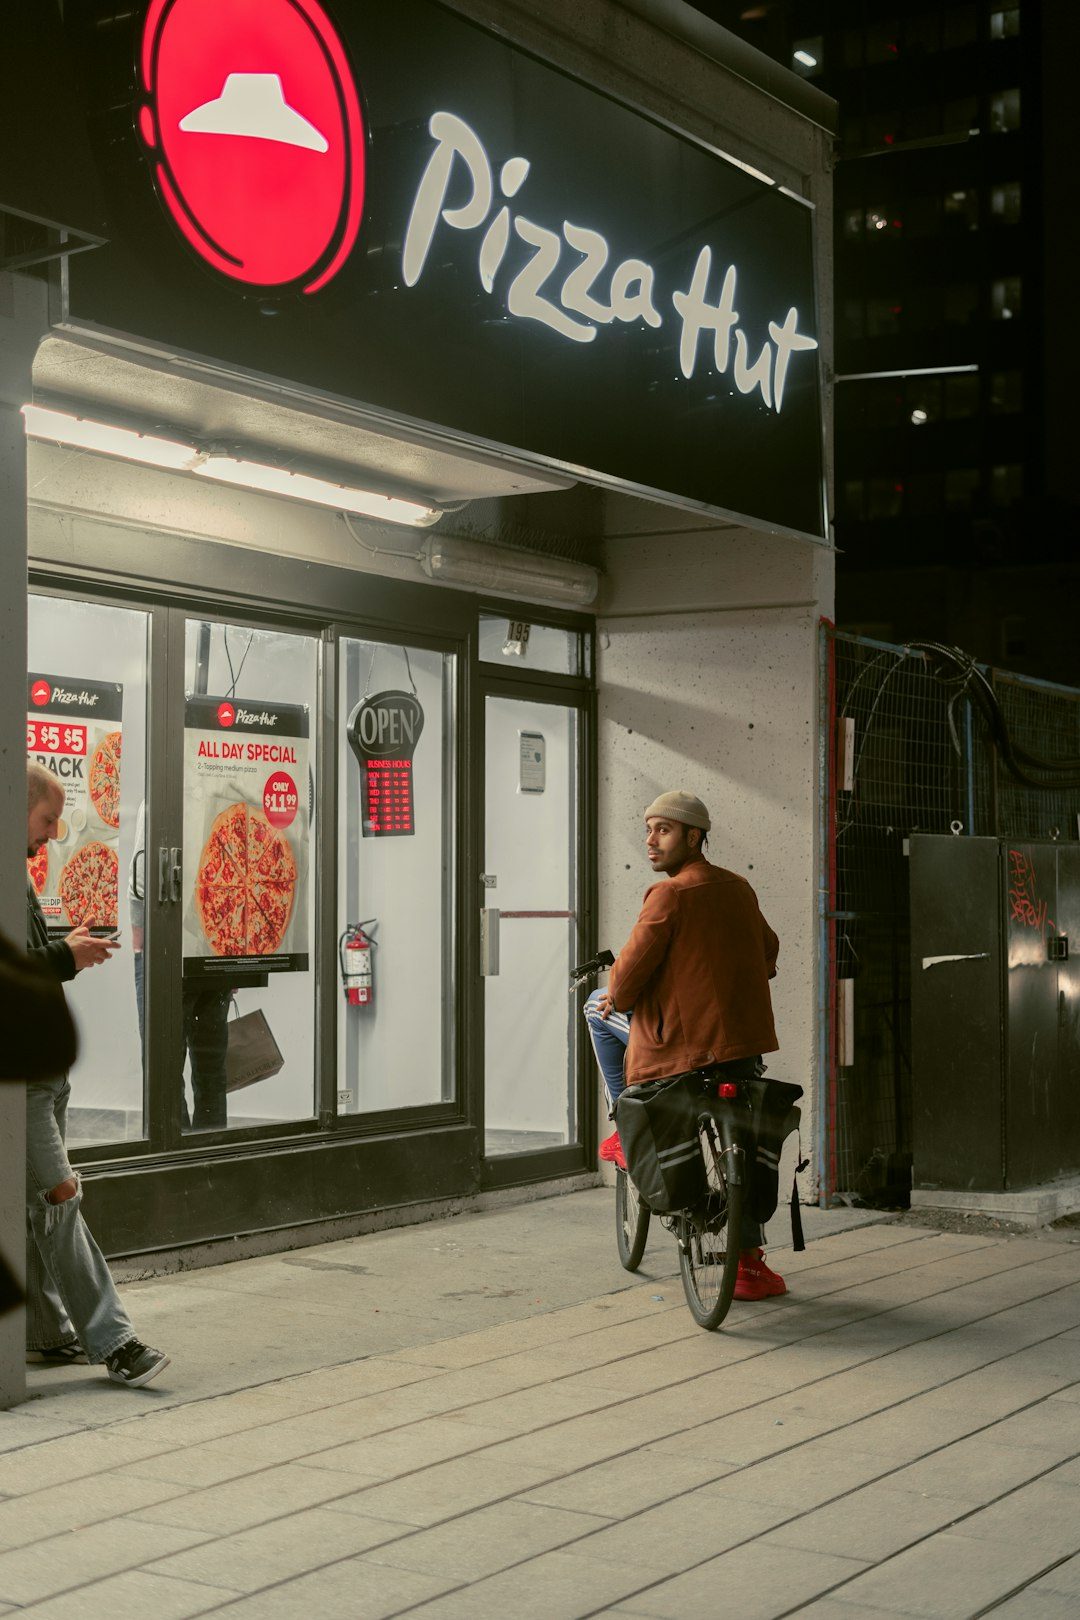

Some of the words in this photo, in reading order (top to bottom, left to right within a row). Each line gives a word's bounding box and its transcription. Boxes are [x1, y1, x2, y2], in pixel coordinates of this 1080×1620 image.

[402, 111, 662, 343] Pizza
[672, 245, 819, 413] Hut
[510, 622, 530, 642] 195
[51, 687, 78, 704] Pizza
[78, 691, 99, 706] Hut
[235, 709, 260, 725] Pizza
[259, 711, 278, 726] Hut
[360, 706, 414, 745] OPEN
[27, 724, 37, 748] 5
[41, 725, 60, 750] $5
[64, 727, 84, 752] $5
[198, 741, 219, 758] ALL
[222, 742, 244, 760] DAY
[247, 743, 297, 764] SPECIAL
[272, 781, 290, 792] ONLY
[50, 898, 61, 906] DIP
